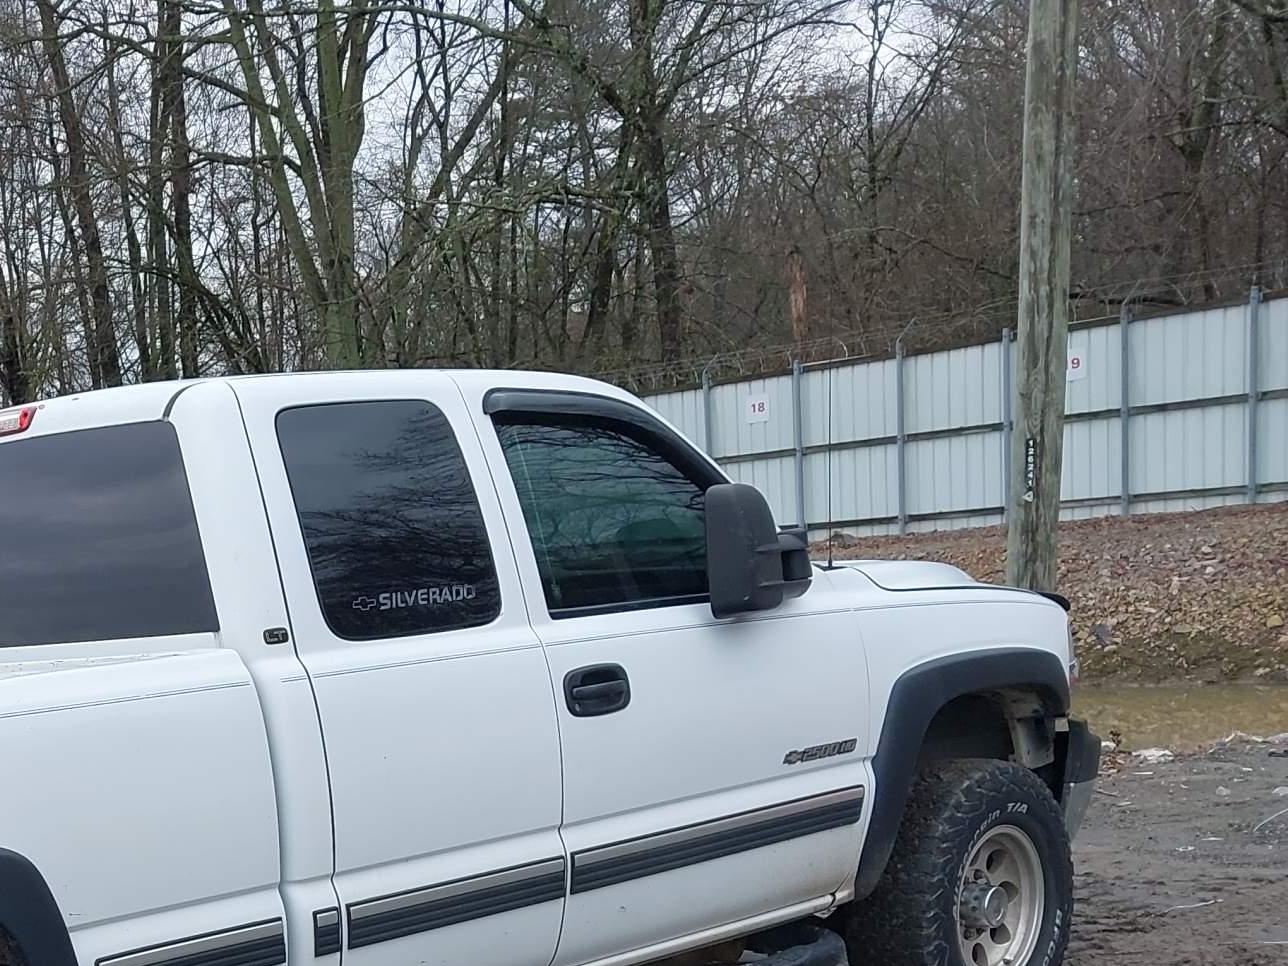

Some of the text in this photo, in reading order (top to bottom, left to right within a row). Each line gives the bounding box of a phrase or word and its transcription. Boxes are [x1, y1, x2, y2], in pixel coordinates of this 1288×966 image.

[750, 402, 766, 414] 18
[378, 583, 477, 611] SILVERADO
[1006, 802, 1029, 815] T/A
